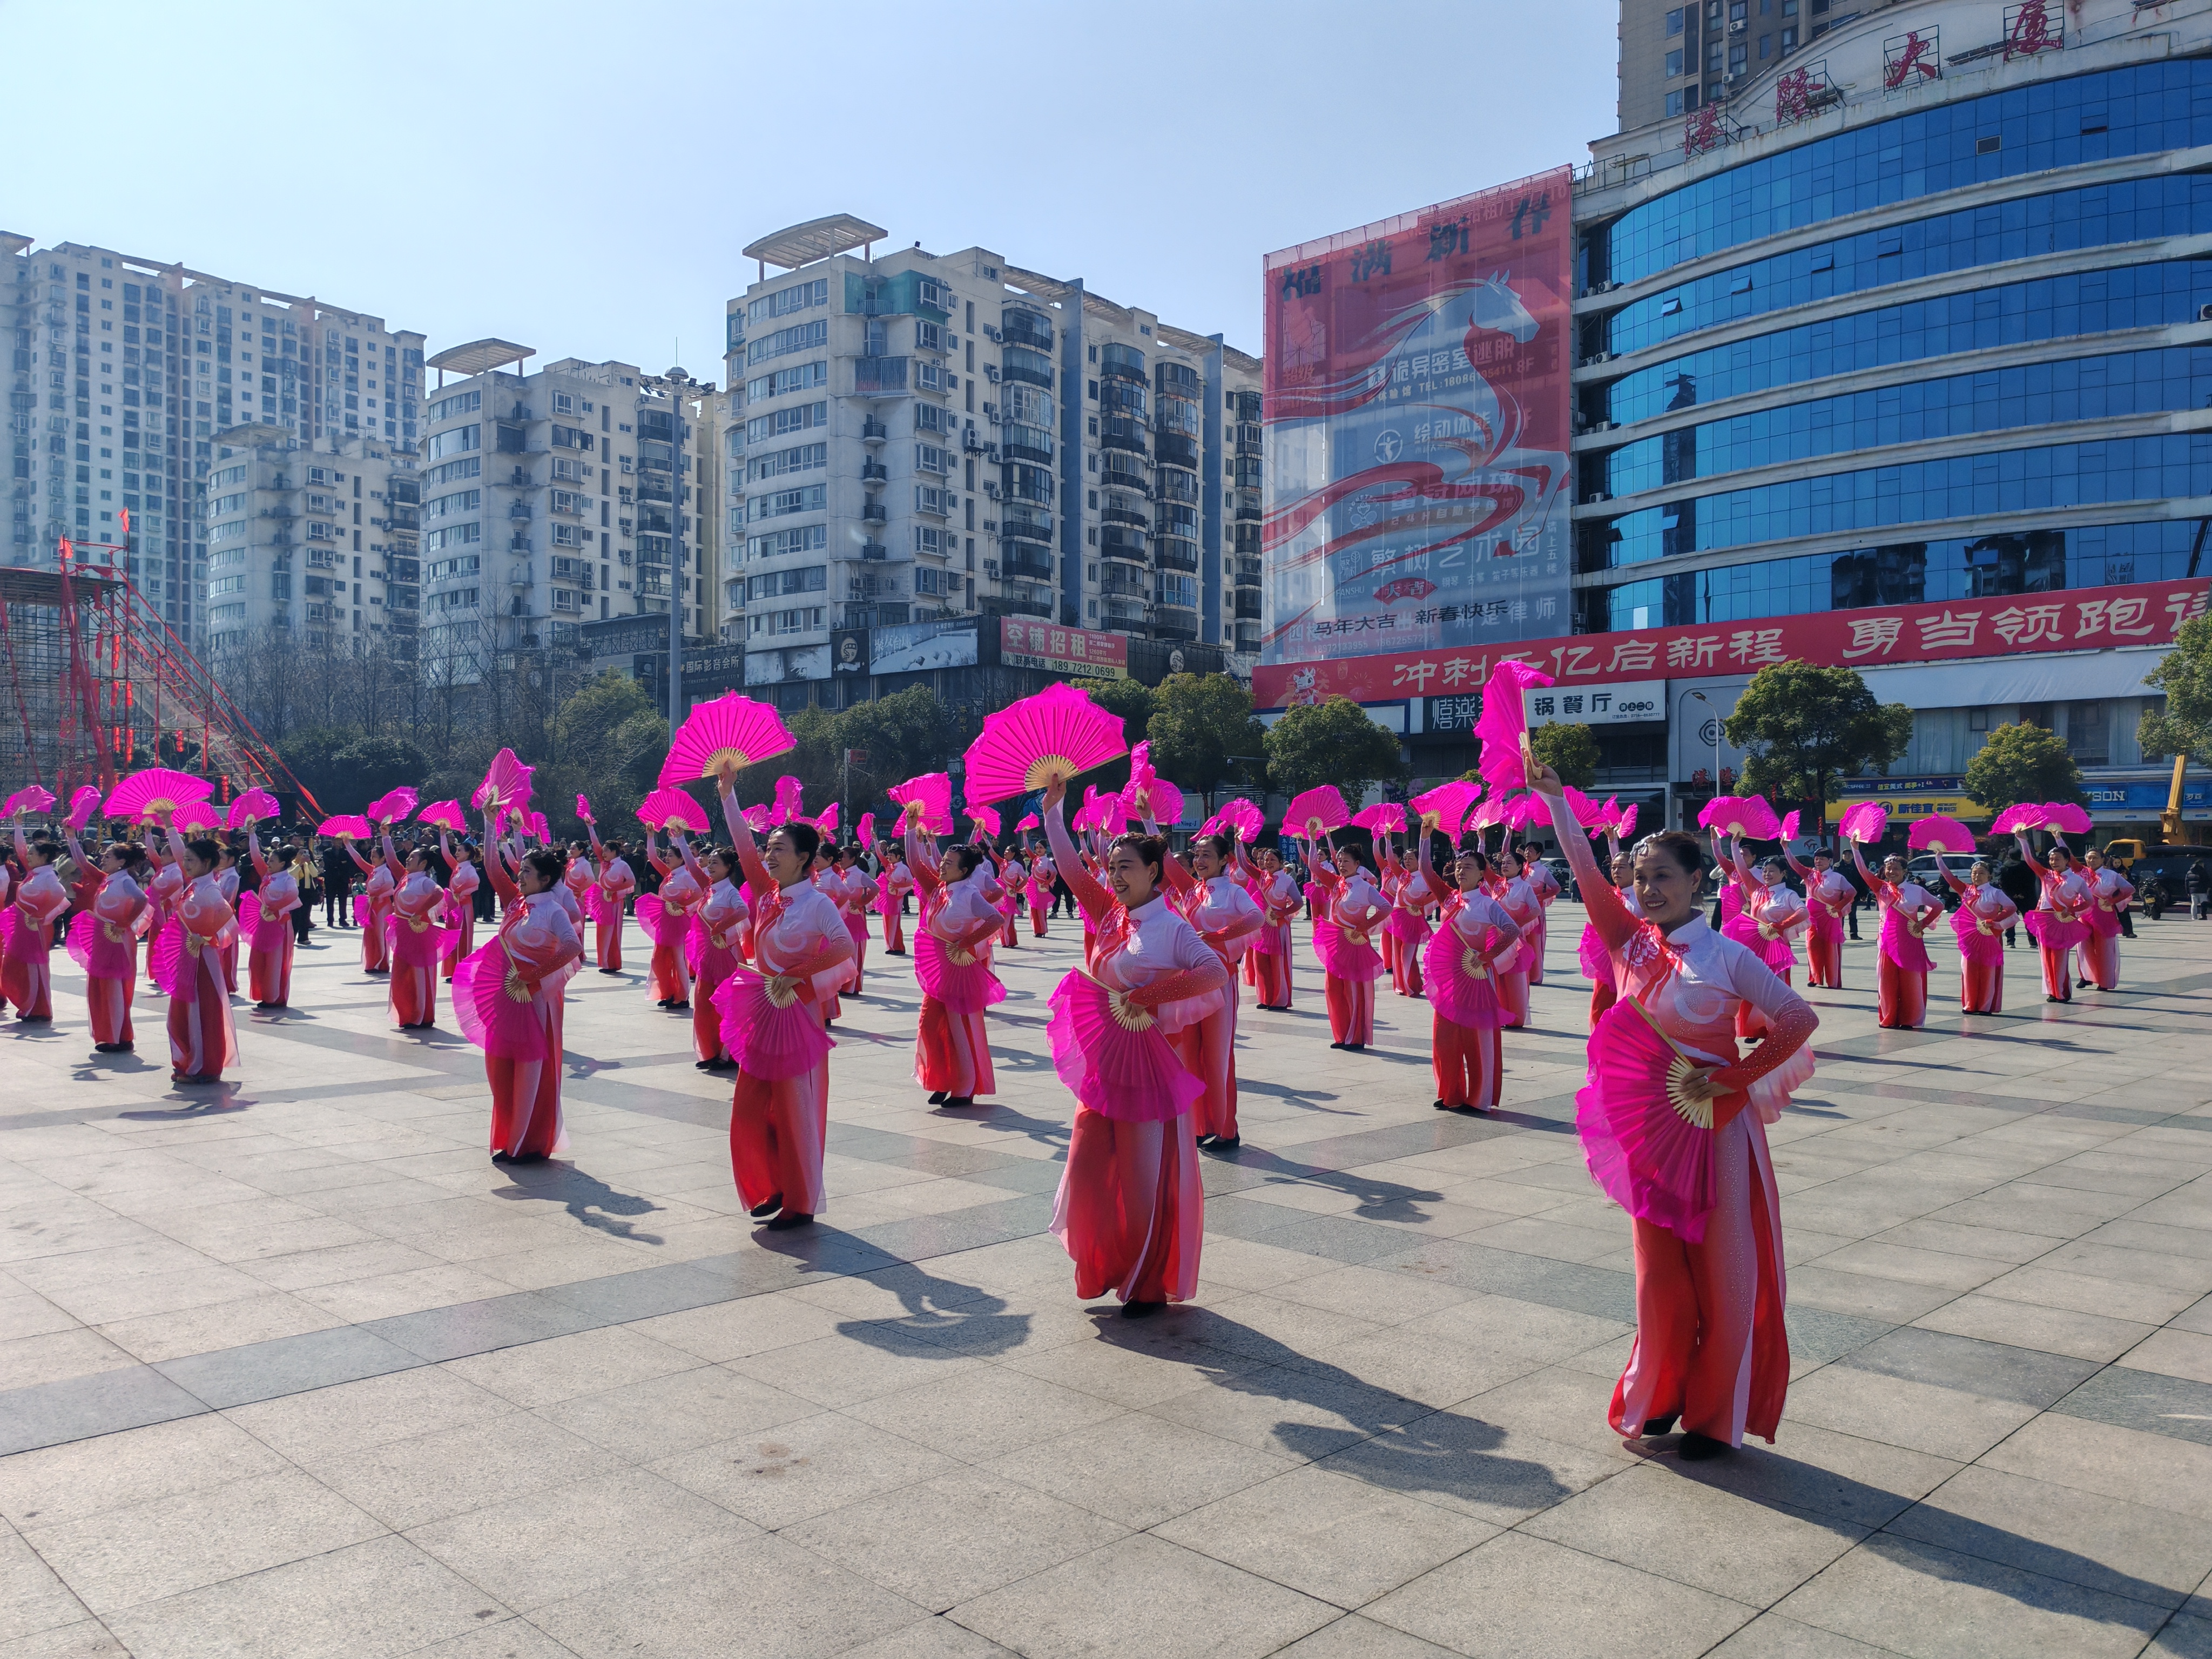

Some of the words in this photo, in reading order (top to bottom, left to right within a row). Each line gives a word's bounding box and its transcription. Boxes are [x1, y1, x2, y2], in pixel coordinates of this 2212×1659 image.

[1393, 335, 1515, 383] 诡异密室逃脱
[1371, 525, 1540, 577] 繁树艺术园
[1546, 521, 1559, 575] 请上五楼
[1442, 575, 1459, 588] 钢琴
[1492, 564, 1539, 583] 笛子等乐器
[1314, 613, 1398, 636] 马年大吉
[1414, 599, 1510, 625] 新春快乐
[1007, 624, 1086, 657] 空铺招租
[686, 656, 739, 673] 国际影音会所
[1015, 655, 1046, 669] 联系电话
[1053, 660, 1068, 671] 189
[1072, 662, 1091, 674] 7212
[1095, 665, 1115, 677] 0699
[1534, 693, 1612, 716] 锅餐厅
